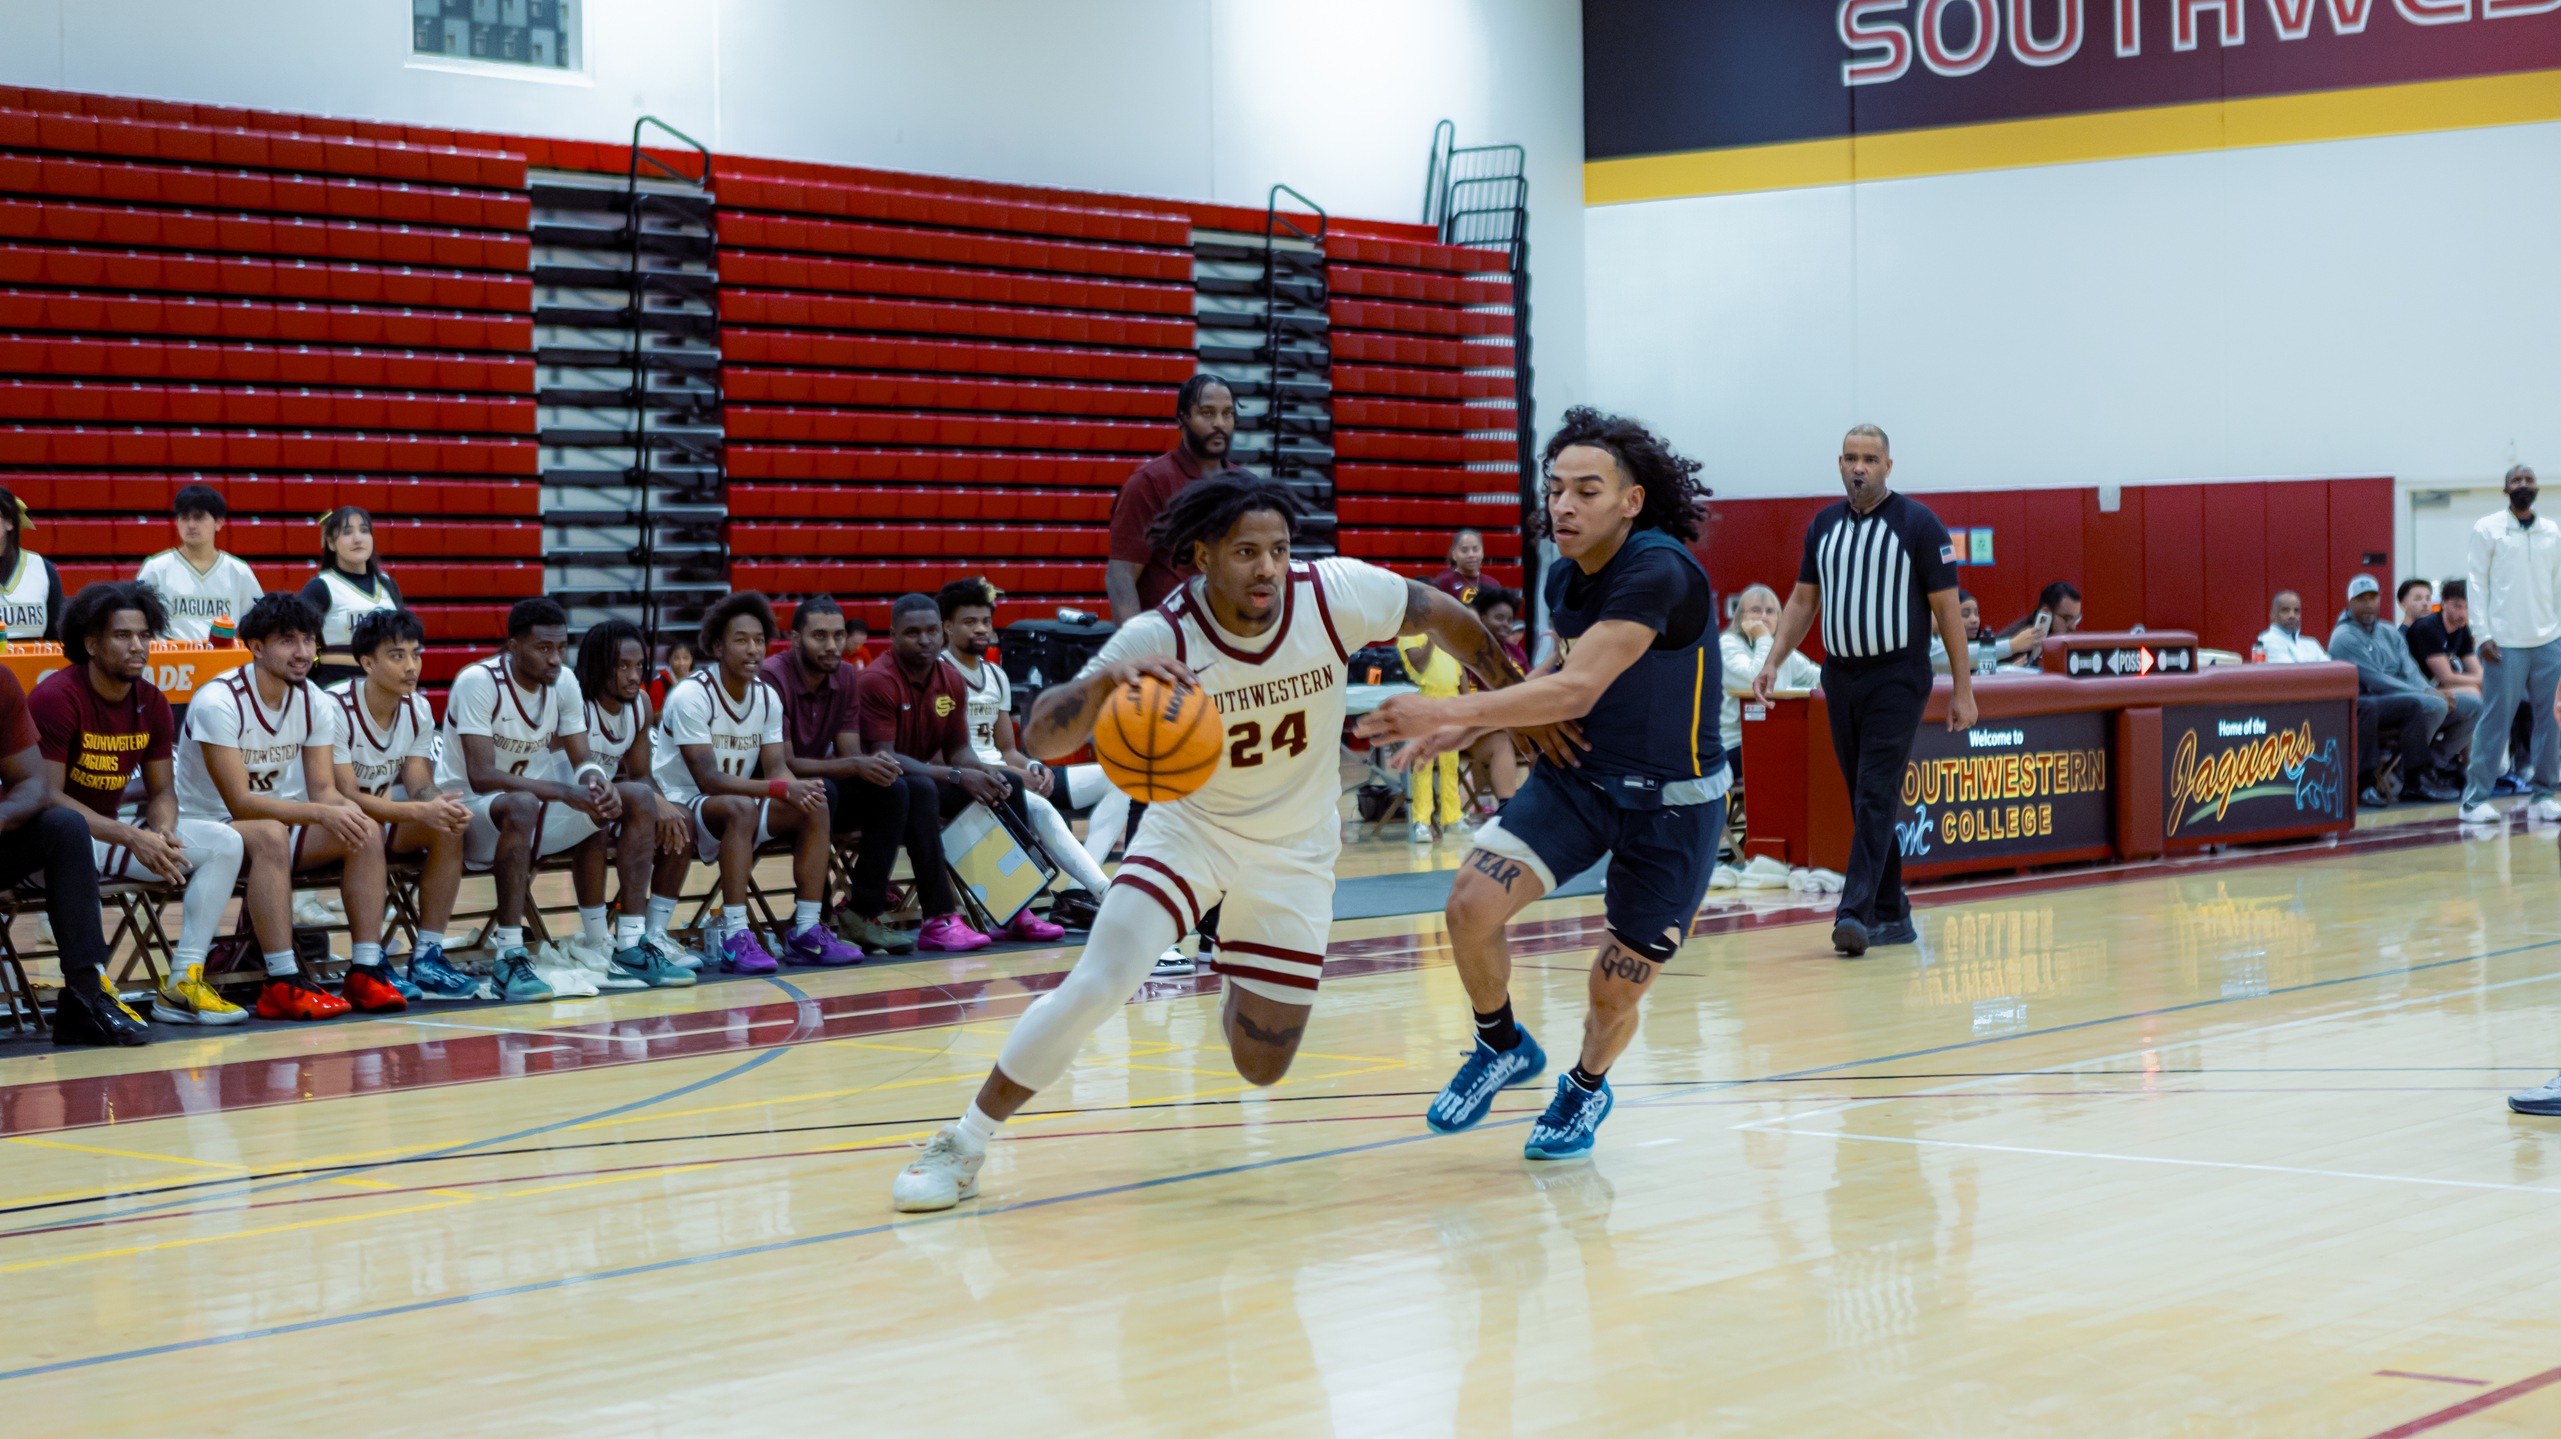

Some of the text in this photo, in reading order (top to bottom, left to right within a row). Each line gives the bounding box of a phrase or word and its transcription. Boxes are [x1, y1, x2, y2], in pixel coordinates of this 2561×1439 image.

[0, 605, 45, 626] UARS
[173, 598, 232, 617] JAGUARS
[2119, 652, 2142, 673] POSS
[1212, 664, 1335, 715] UTHWESTERN
[1227, 708, 1309, 769] 24
[1969, 728, 2024, 747] Welcome to
[2218, 716, 2267, 736] Home of the
[1901, 749, 2106, 806] OUTHWESTERN
[2166, 719, 2316, 837] Jaguars
[1941, 802, 2053, 845] COLLEGE
[1602, 944, 1652, 984] GOD
